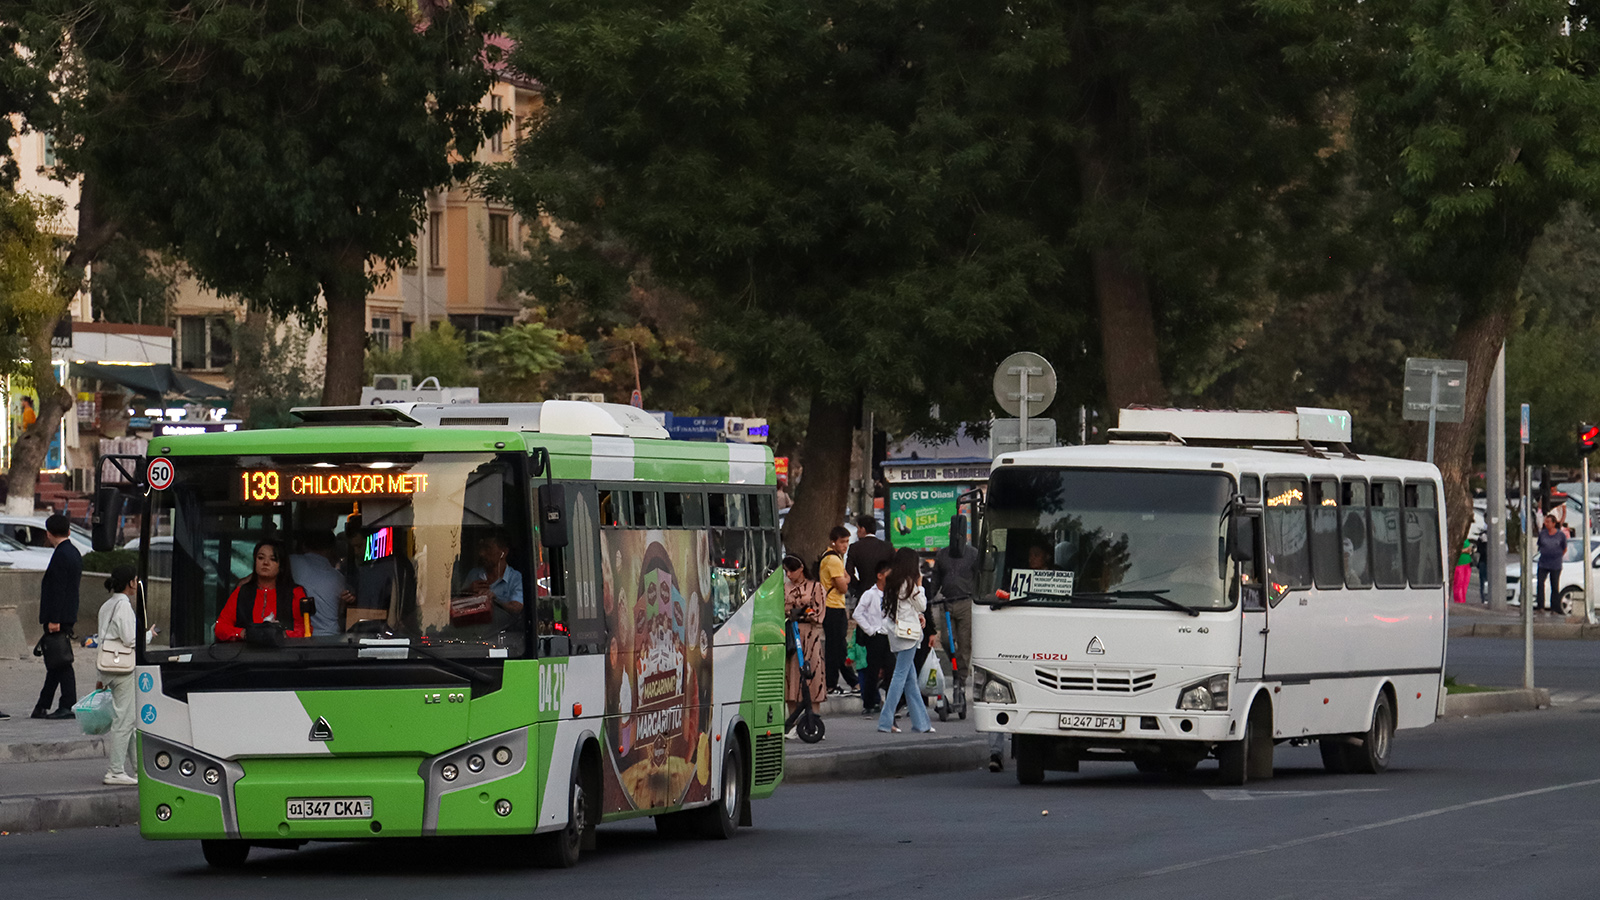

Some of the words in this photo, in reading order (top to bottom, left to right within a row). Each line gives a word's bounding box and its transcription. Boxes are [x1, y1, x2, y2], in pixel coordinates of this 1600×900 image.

[152, 466, 169, 481] 50
[242, 471, 279, 501] 139
[291, 474, 385, 495] CHILONZOR
[892, 491, 918, 500] EVOS
[916, 514, 937, 526] ISH
[1011, 573, 1032, 597] 471
[1032, 653, 1068, 661] ISUZU
[424, 693, 441, 704] LE
[448, 693, 464, 703] 60
[1062, 717, 1071, 725] 01
[1073, 717, 1093, 727] 247
[1095, 718, 1116, 728] DFA
[290, 804, 303, 815] 01
[306, 802, 331, 816] 347
[334, 802, 363, 816] CKA
